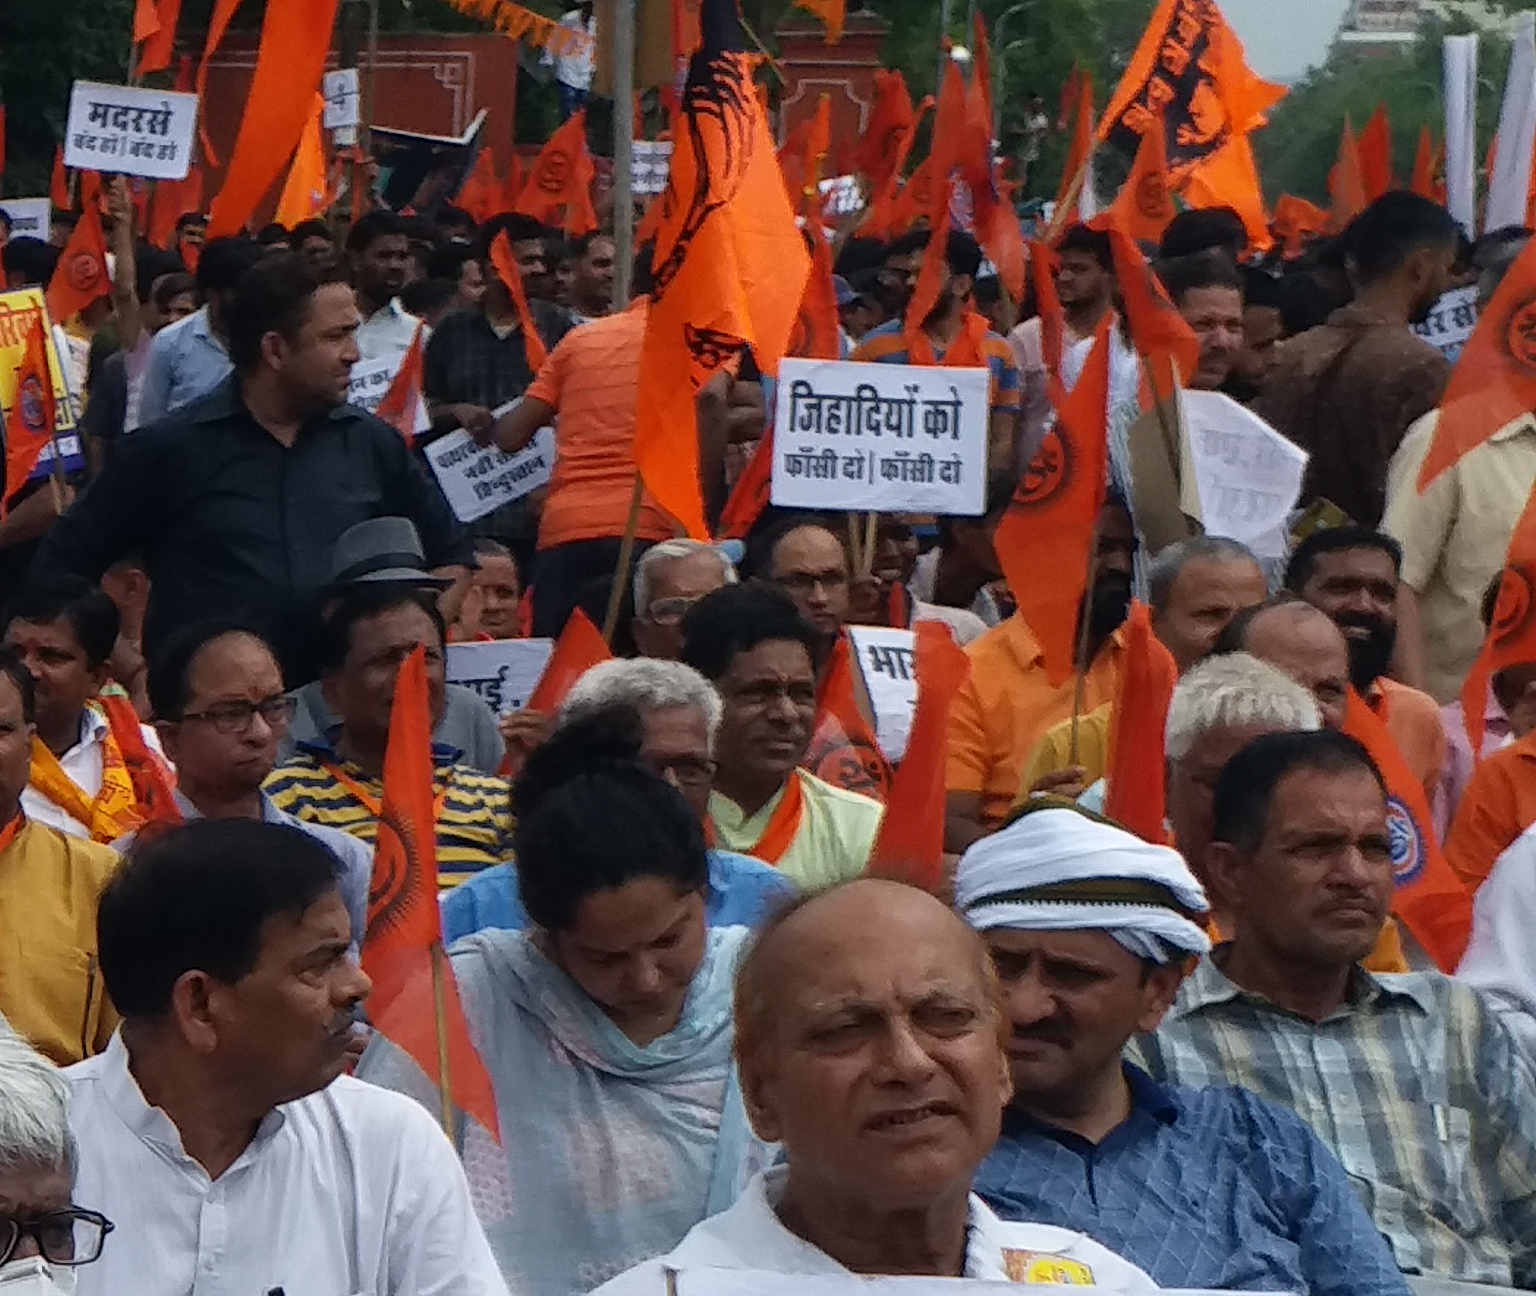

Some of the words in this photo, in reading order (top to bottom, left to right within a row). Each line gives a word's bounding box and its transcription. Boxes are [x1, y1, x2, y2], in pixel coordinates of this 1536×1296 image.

[88, 101, 173, 136] मदरसे
[789, 380, 920, 438] जिहादियों
[921, 385, 964, 440] को
[841, 449, 866, 481] दो
[938, 451, 963, 485] दो
